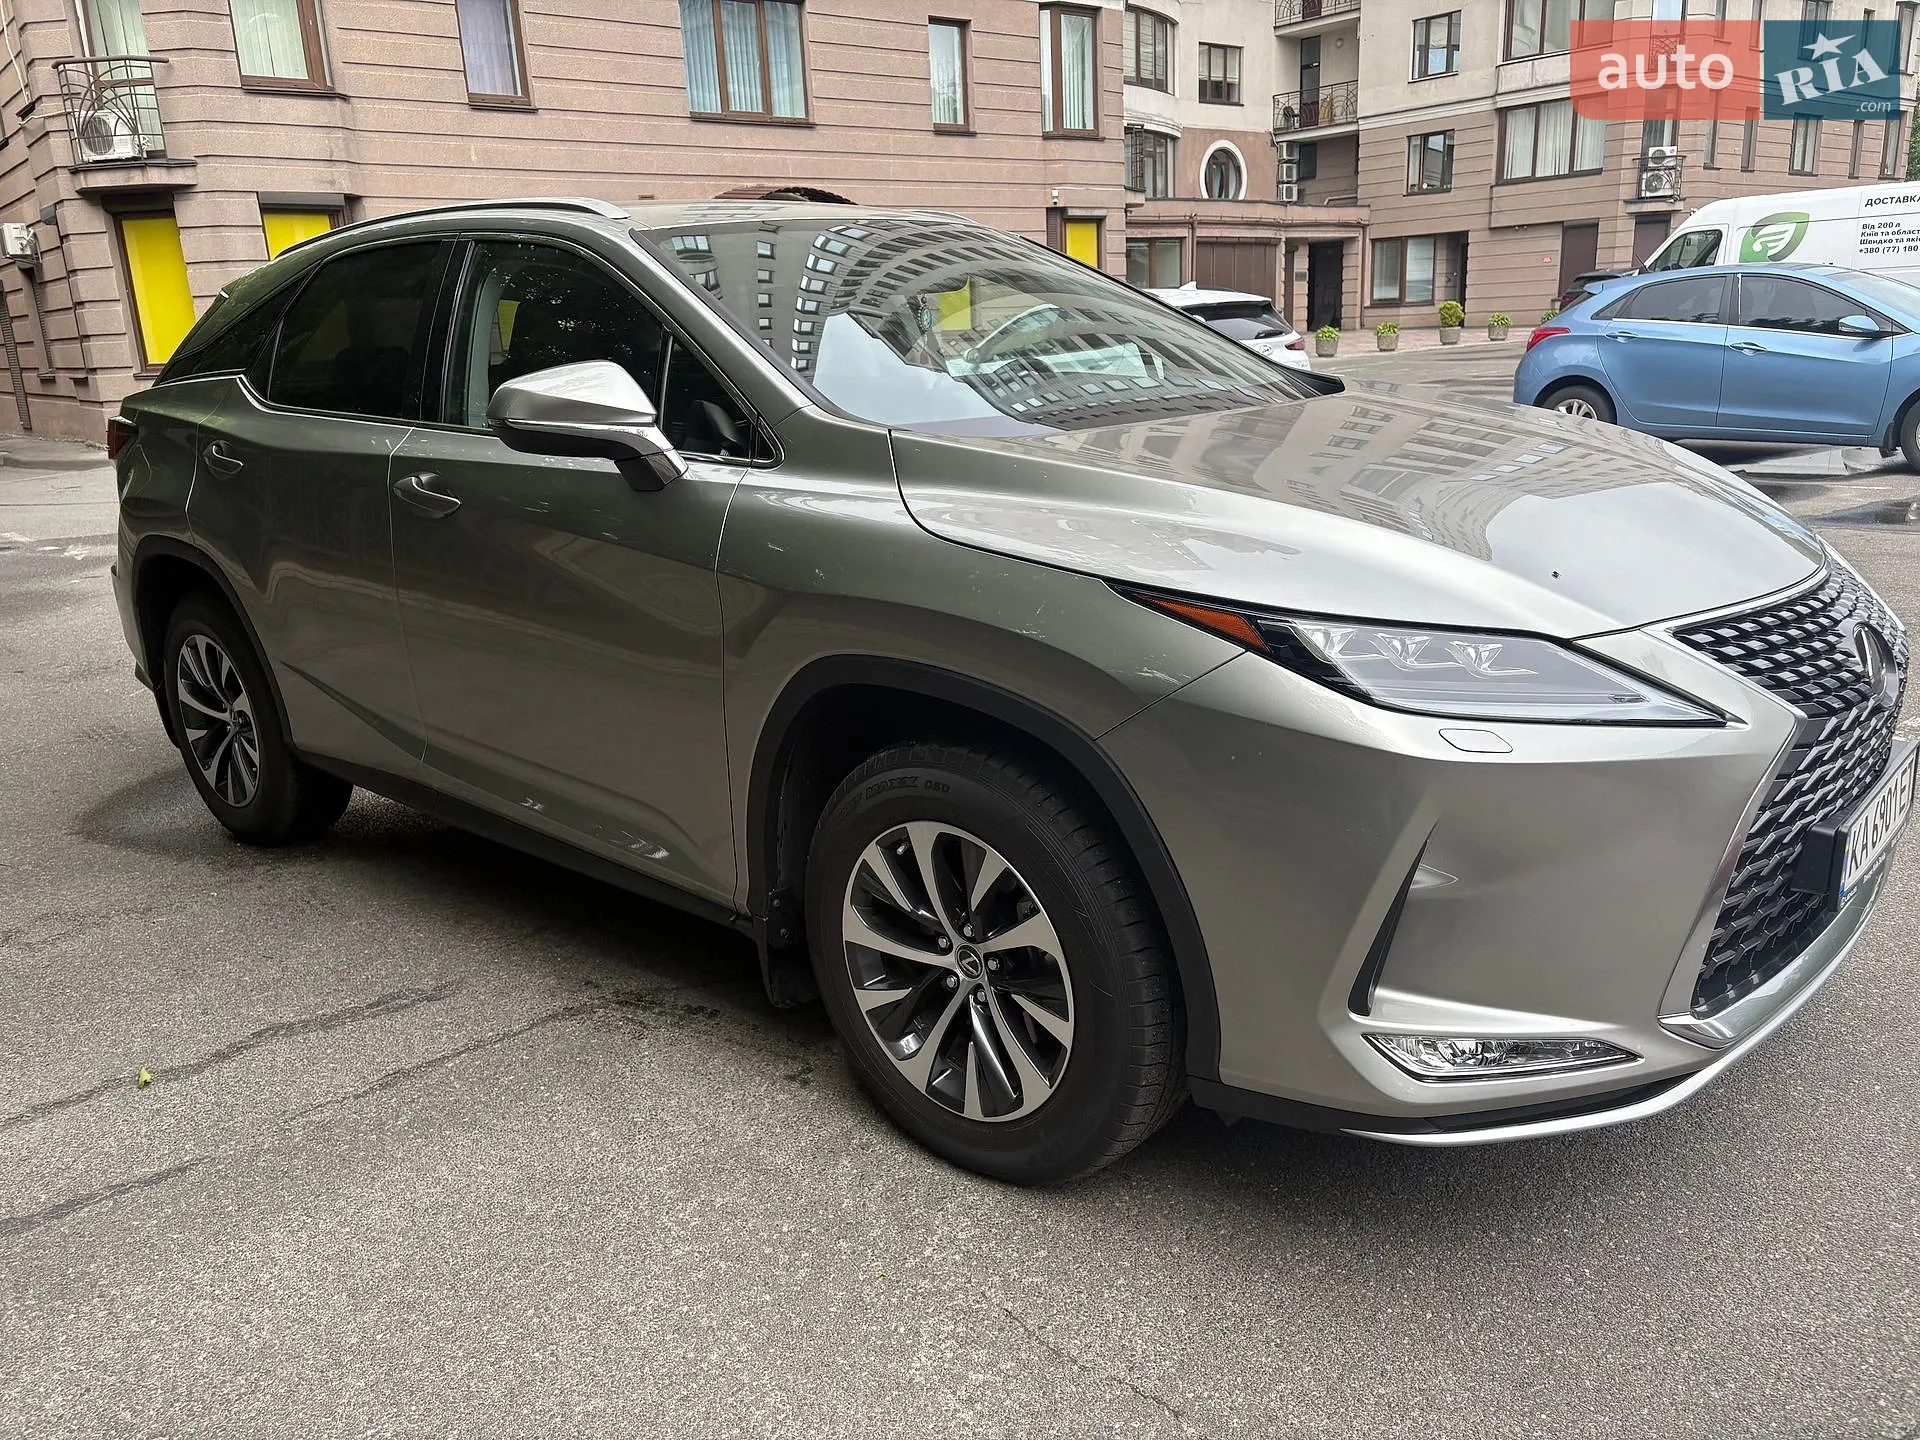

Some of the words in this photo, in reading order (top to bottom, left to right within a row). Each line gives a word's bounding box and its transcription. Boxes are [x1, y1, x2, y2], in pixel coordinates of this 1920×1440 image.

[1865, 195, 1920, 207] ДОСТАВКА
[1882, 246, 1900, 254] (77)
[1848, 814, 1869, 879] KA
[1872, 777, 1899, 850] 6901
